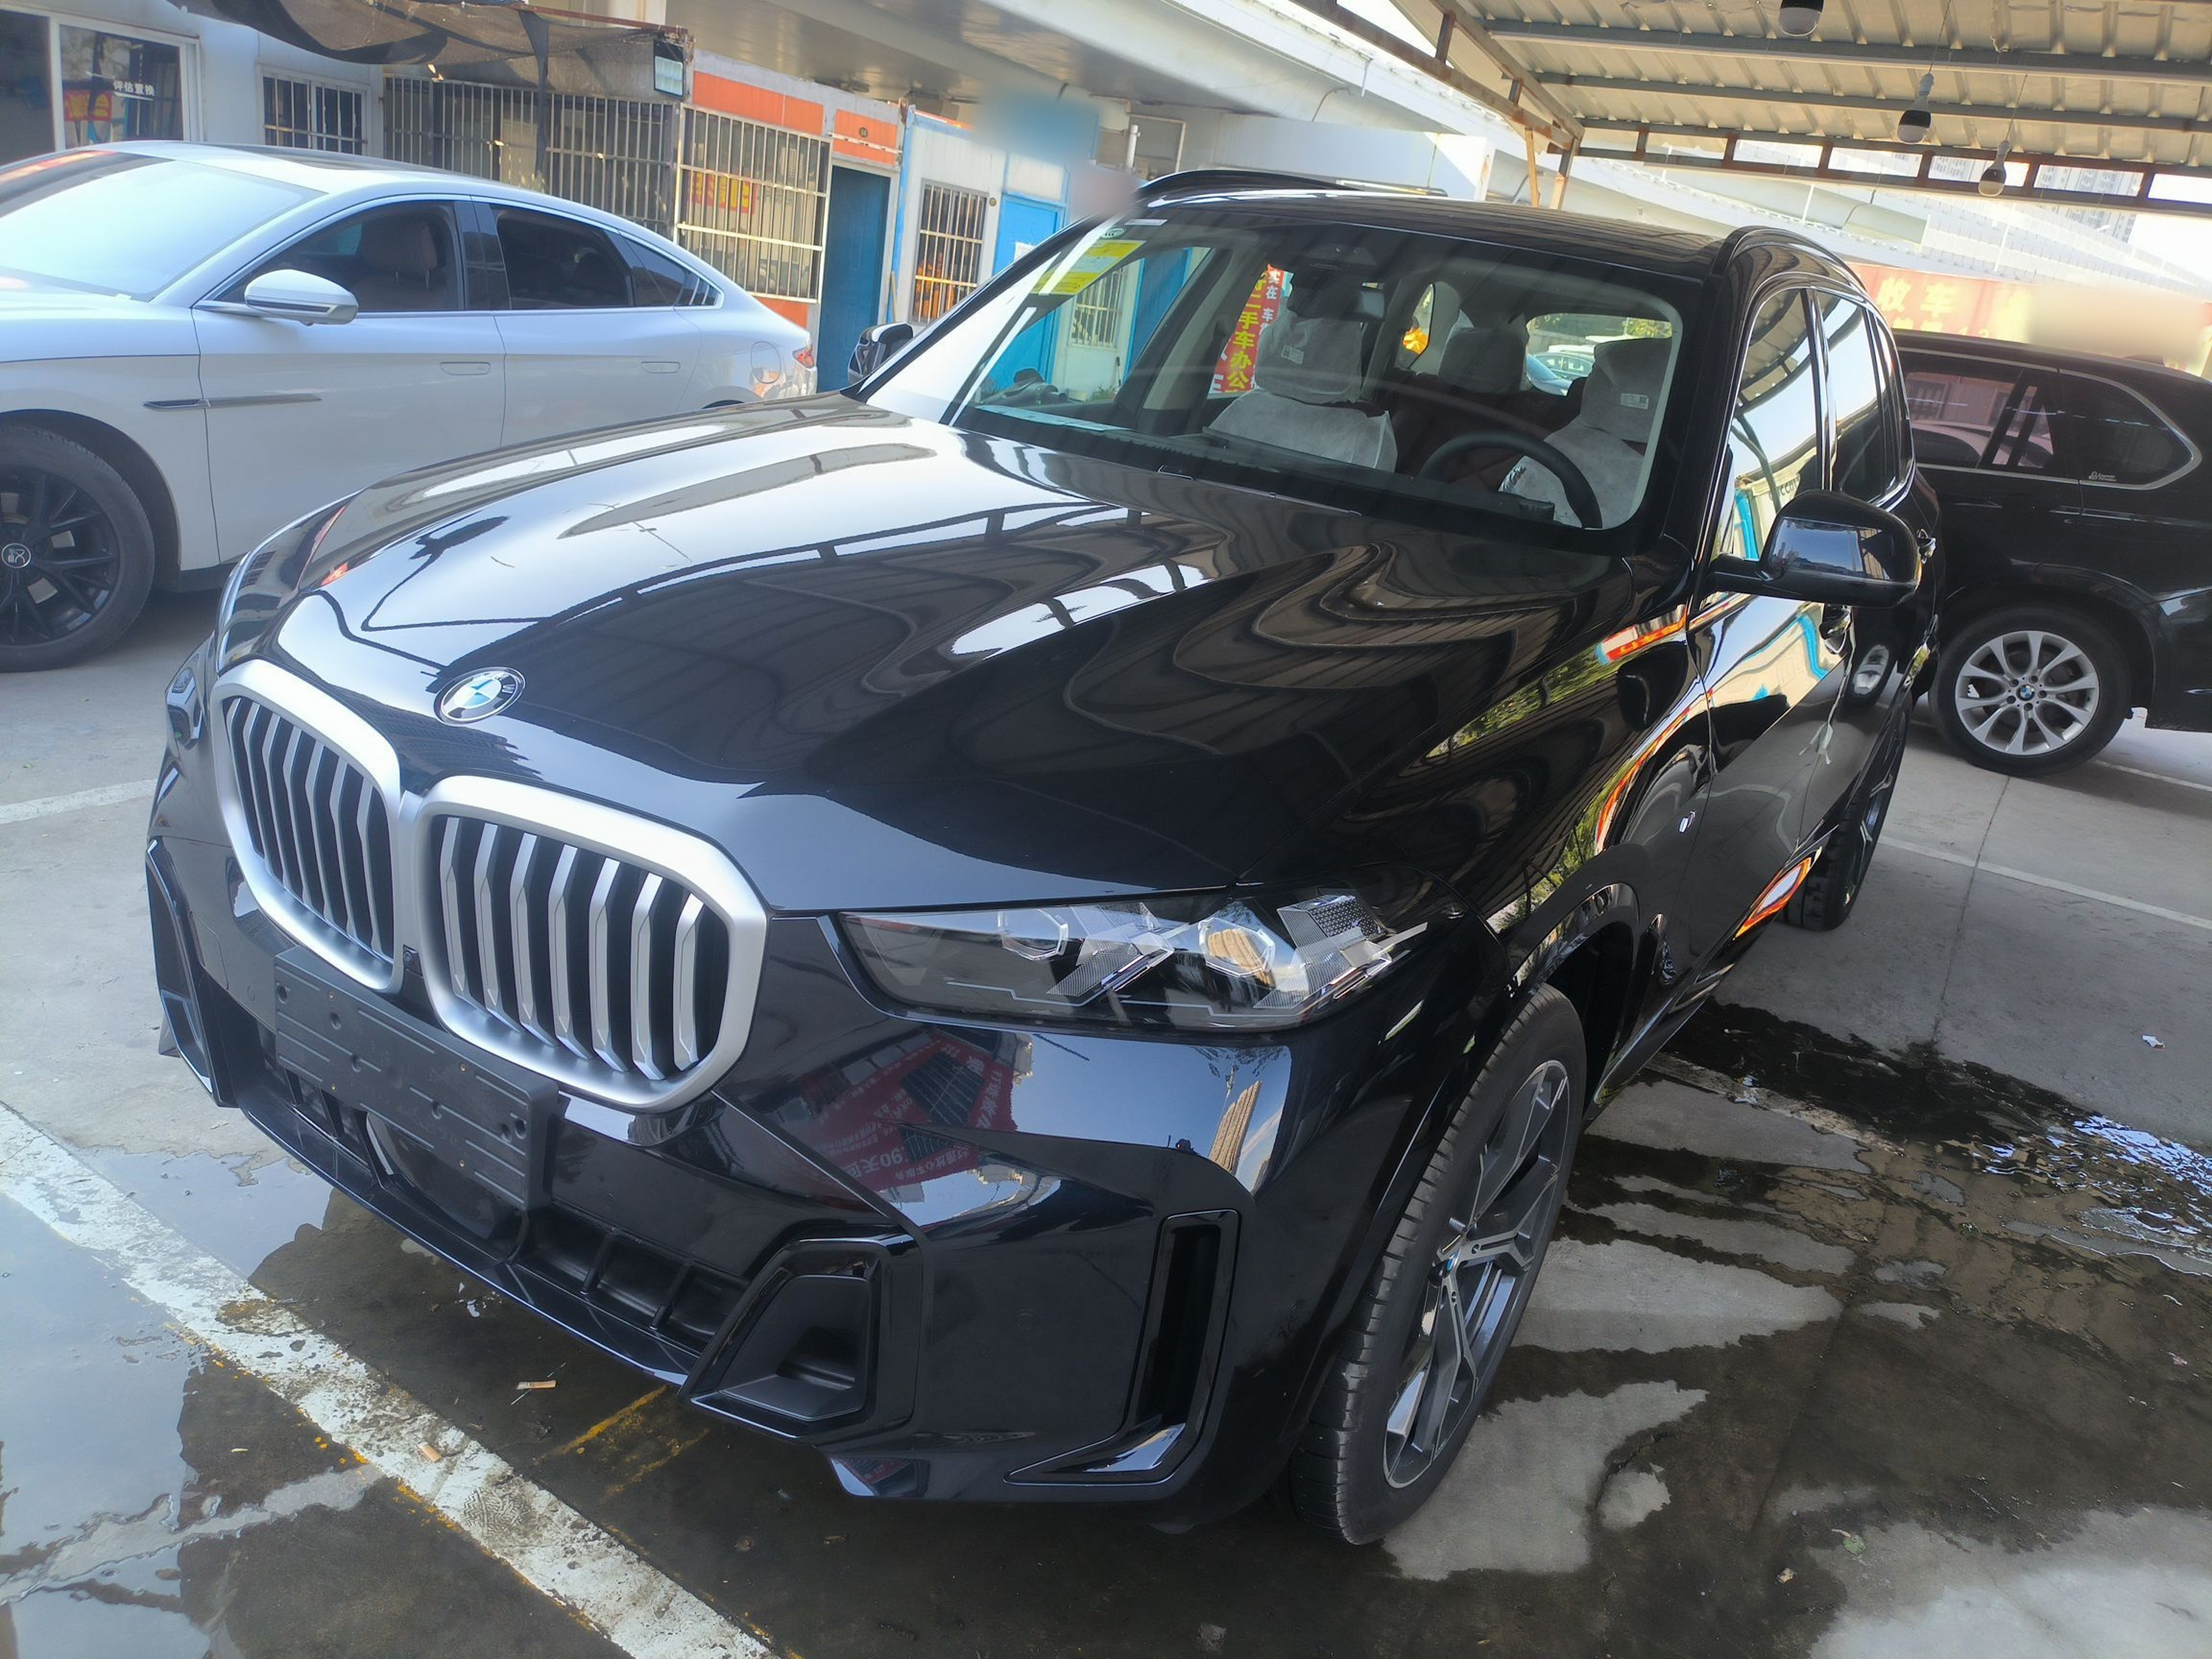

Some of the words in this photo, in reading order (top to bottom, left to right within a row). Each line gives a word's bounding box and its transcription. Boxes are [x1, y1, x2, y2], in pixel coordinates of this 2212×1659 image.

[112, 79, 155, 97] 评估置换
[1225, 272, 1268, 392] 二手车办公
